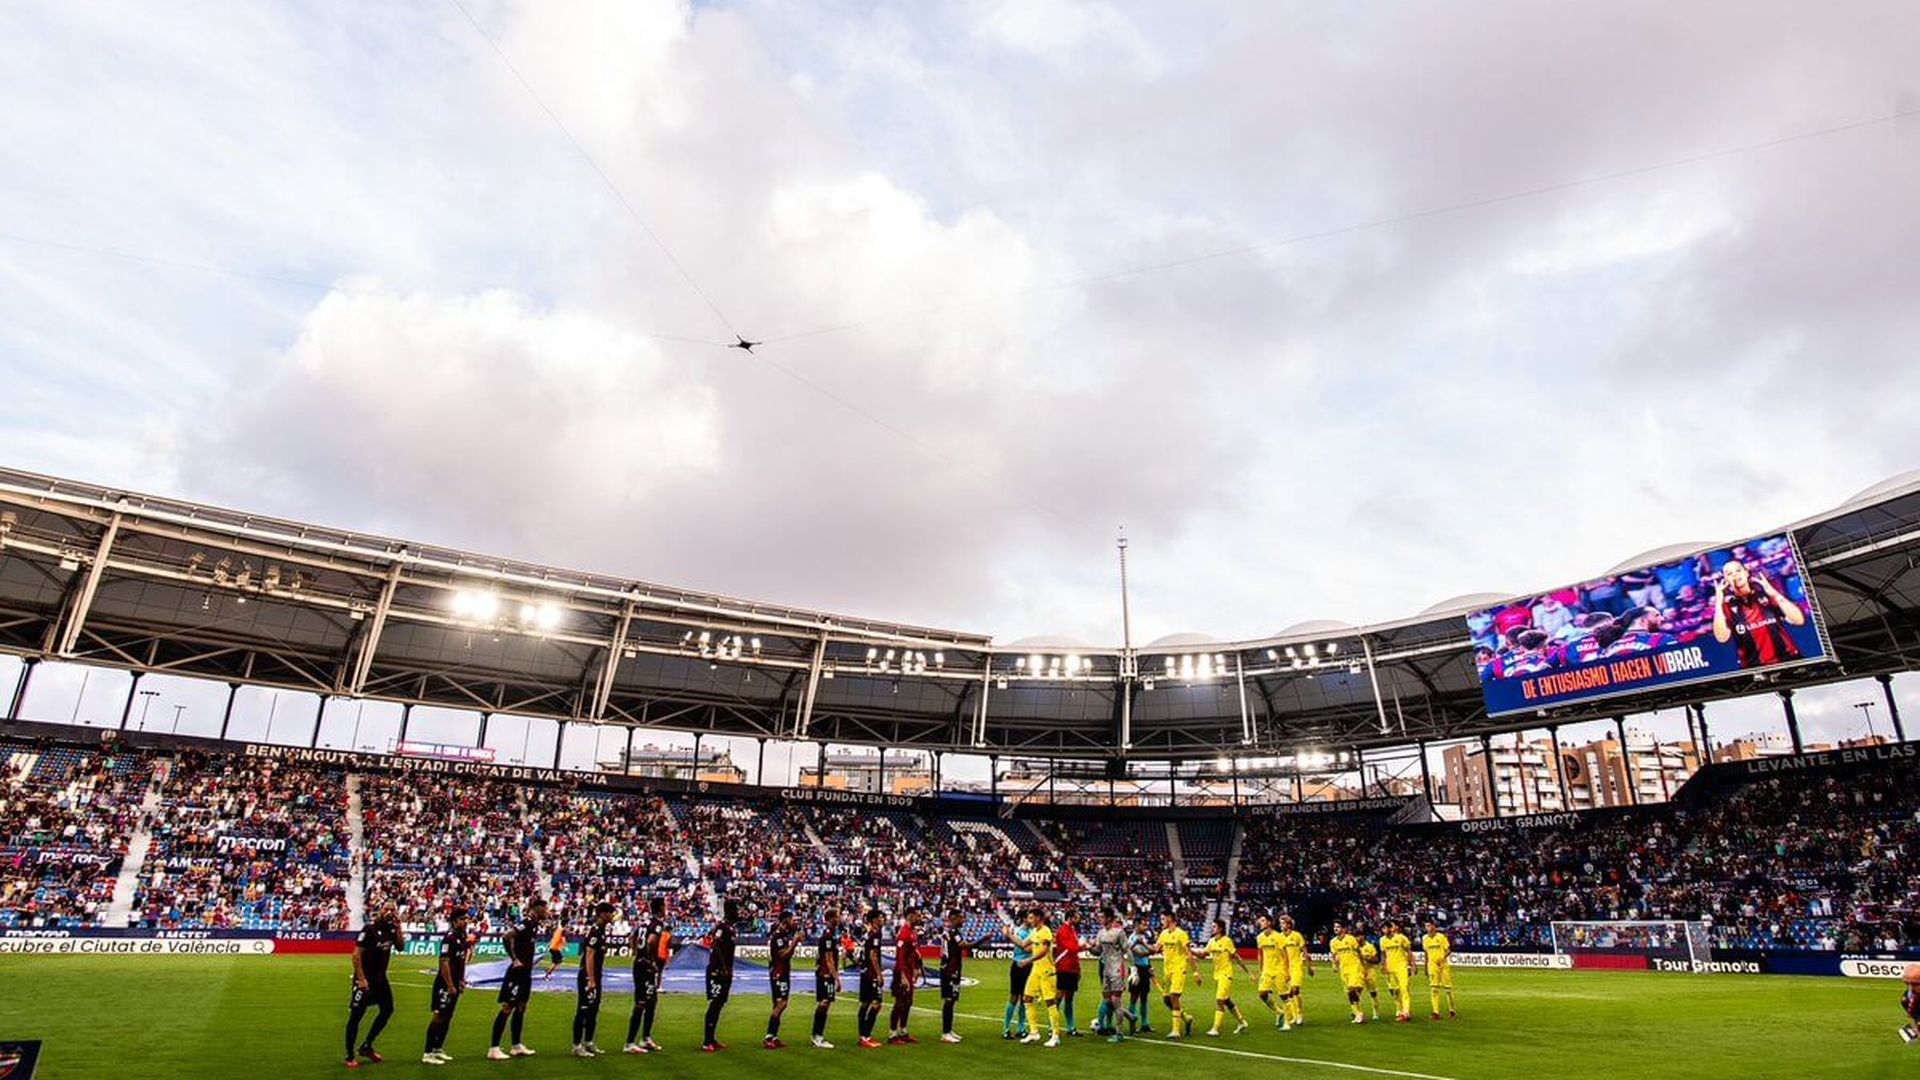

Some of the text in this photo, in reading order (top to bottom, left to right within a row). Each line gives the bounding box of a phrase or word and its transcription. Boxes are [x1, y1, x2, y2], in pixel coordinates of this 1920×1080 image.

[1522, 678, 1538, 699] DE
[1538, 665, 1609, 695] ENTUSIASMO
[1610, 657, 1652, 684] HACEN
[1653, 646, 1710, 675] VIBRAR.
[1842, 750, 1869, 762] EN
[1876, 746, 1917, 759] LAS
[512, 768, 532, 779] DE
[781, 790, 914, 806] CLUB FUNDAT EN 1909
[1322, 802, 1335, 812] ES
[1337, 801, 1357, 811] SER
[59, 940, 76, 952] el
[80, 940, 139, 953] Ciutat
[140, 940, 162, 953] de
[168, 941, 241, 953] València
[971, 948, 995, 958] Tour
[1449, 954, 1482, 964] Ciutat
[1486, 955, 1498, 965] de
[1652, 958, 1760, 973] Tour Granota
